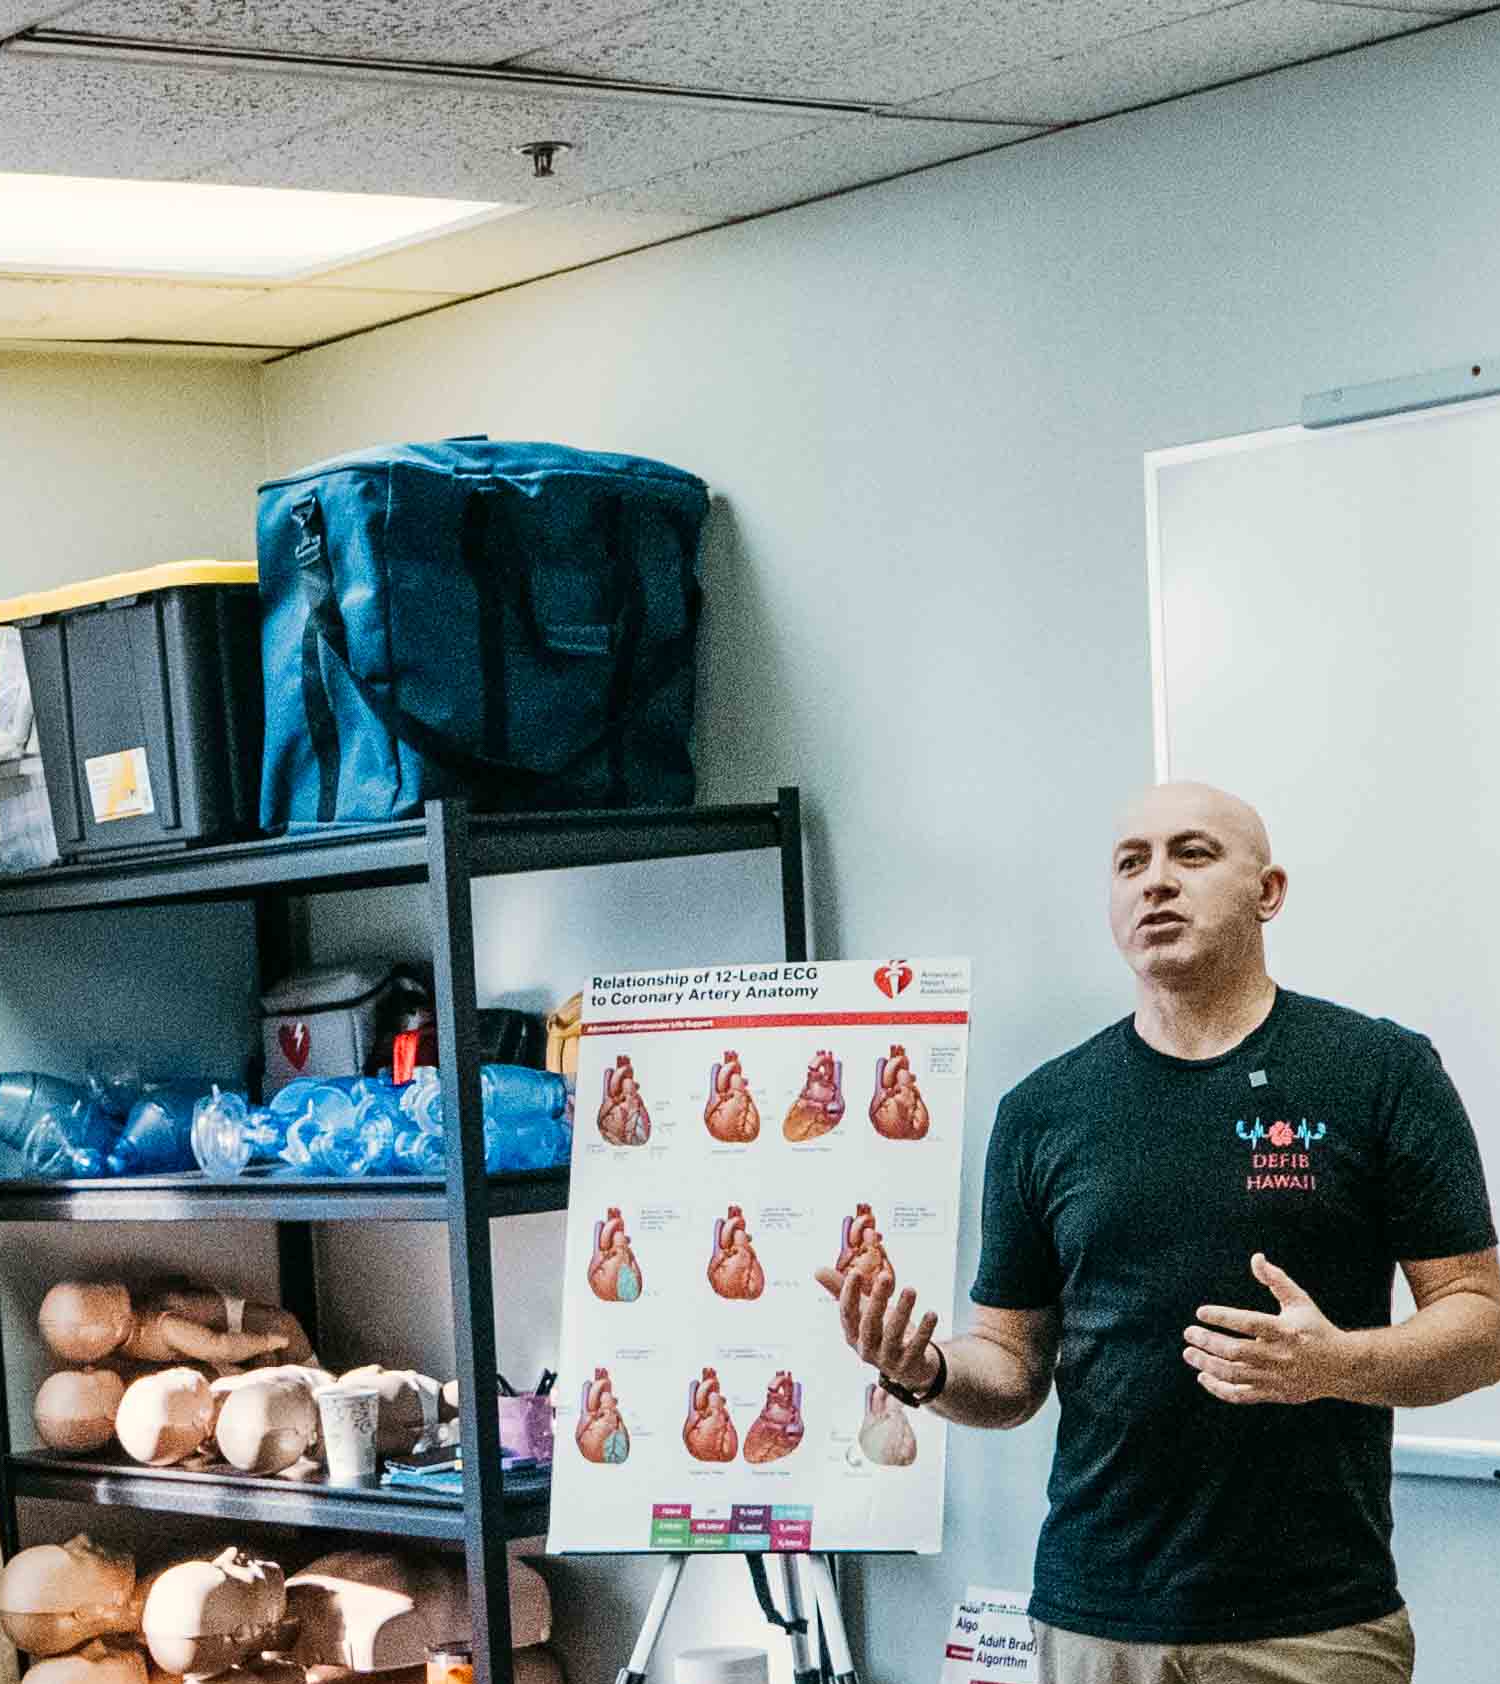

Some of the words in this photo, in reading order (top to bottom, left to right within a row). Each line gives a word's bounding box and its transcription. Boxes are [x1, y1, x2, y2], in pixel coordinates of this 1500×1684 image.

[592, 972, 689, 990] Relationship
[693, 970, 709, 984] of
[716, 968, 778, 983] 12-Lead
[783, 966, 818, 981] ECG
[591, 994, 607, 1007] to
[611, 991, 684, 1006] Coronary
[688, 987, 740, 1003] Artery
[745, 984, 819, 1000] Anatomy
[1252, 1152, 1310, 1169] DEFIB
[1246, 1174, 1316, 1191] HAWAII
[978, 1634, 1007, 1650] Adult
[976, 1650, 1028, 1669] Algorithm
